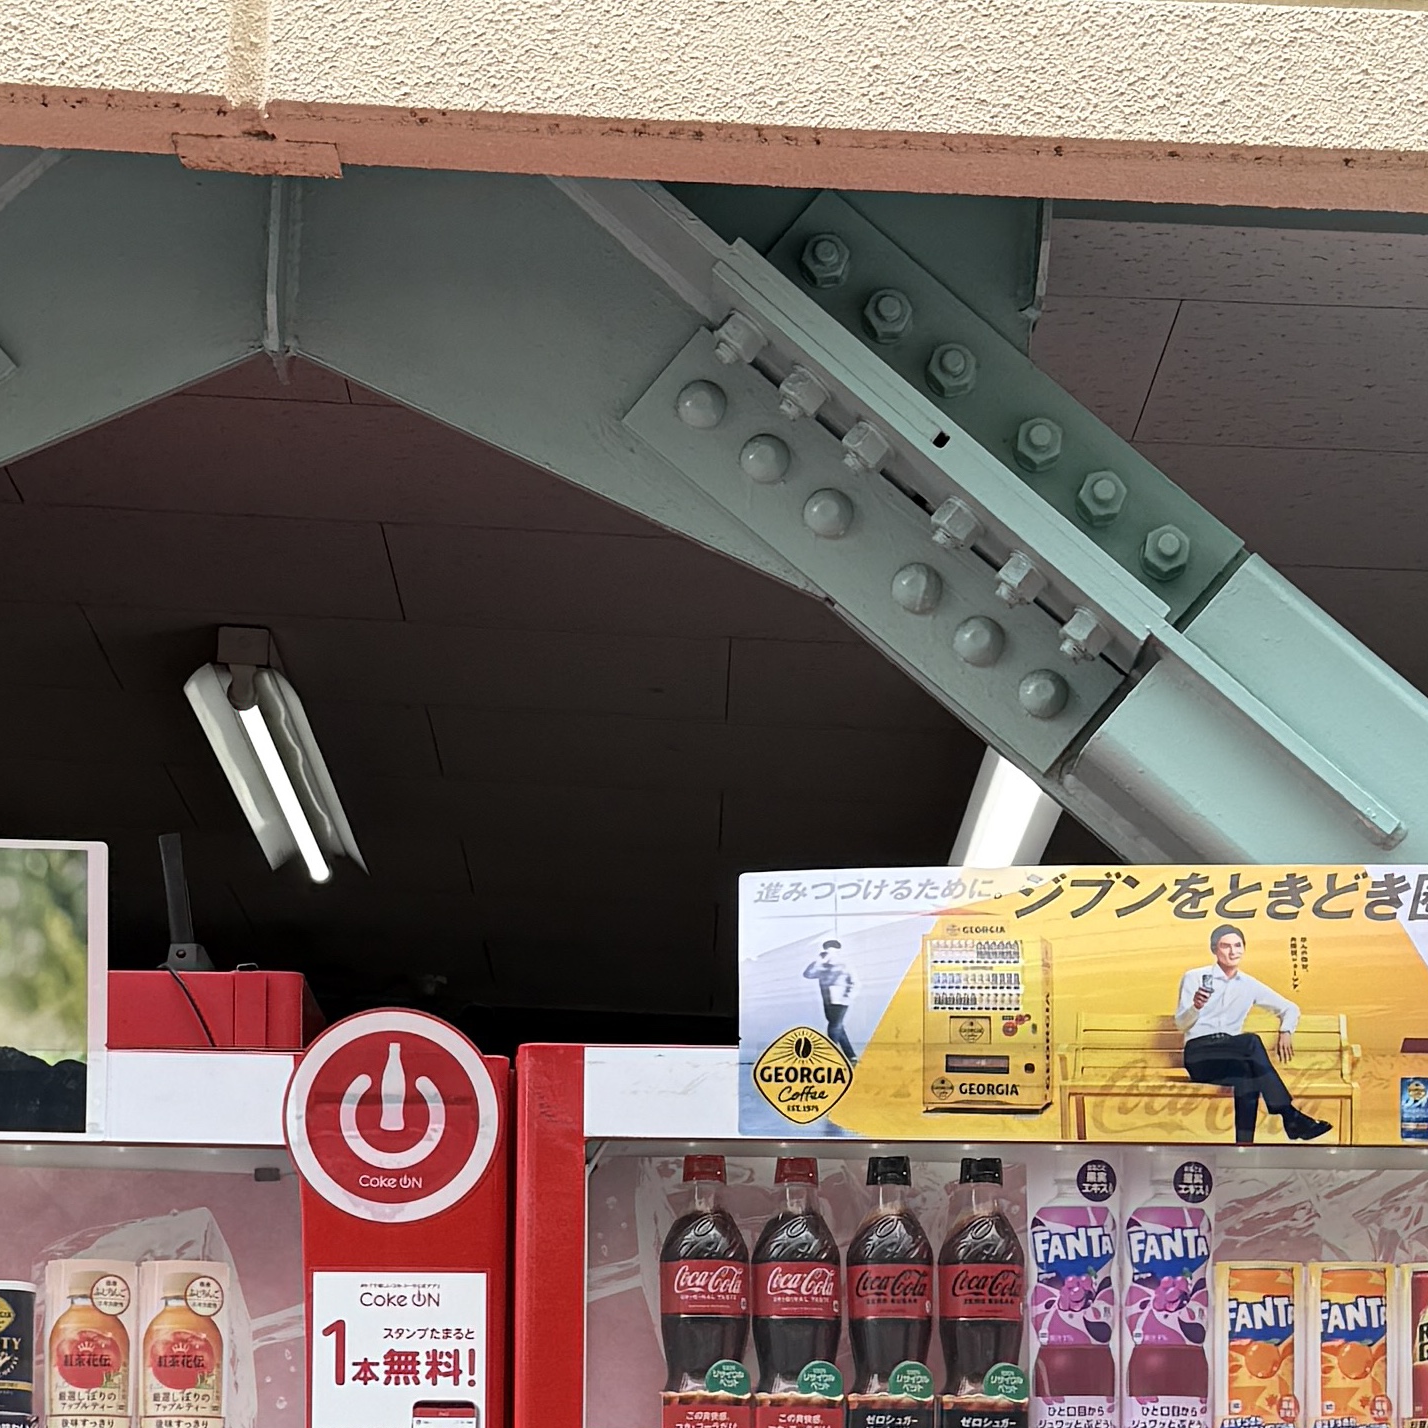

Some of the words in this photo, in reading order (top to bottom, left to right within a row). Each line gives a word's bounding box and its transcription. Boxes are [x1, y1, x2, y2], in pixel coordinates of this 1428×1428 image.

[754, 877, 1002, 903] 進みつづけるために。
[759, 1066, 847, 1086] GEORGIA
[778, 1085, 829, 1103] Coffee
[958, 1082, 1020, 1097] GEORGIA
[359, 1175, 397, 1189] Coke
[399, 1174, 423, 1189] ON
[1033, 1225, 1113, 1264] FANTA
[1129, 1226, 1208, 1264] FANTA
[674, 1265, 743, 1294] Coca-Cola
[767, 1266, 835, 1296] Coca-Cola
[360, 1291, 408, 1308] Coke
[411, 1286, 440, 1307] ON
[383, 1327, 476, 1340] スタンプたまると
[322, 1319, 476, 1387] 1本無料!
[865, 1414, 919, 1425] ゼロシュガー
[959, 1415, 1016, 1427] ゼロシュガー
